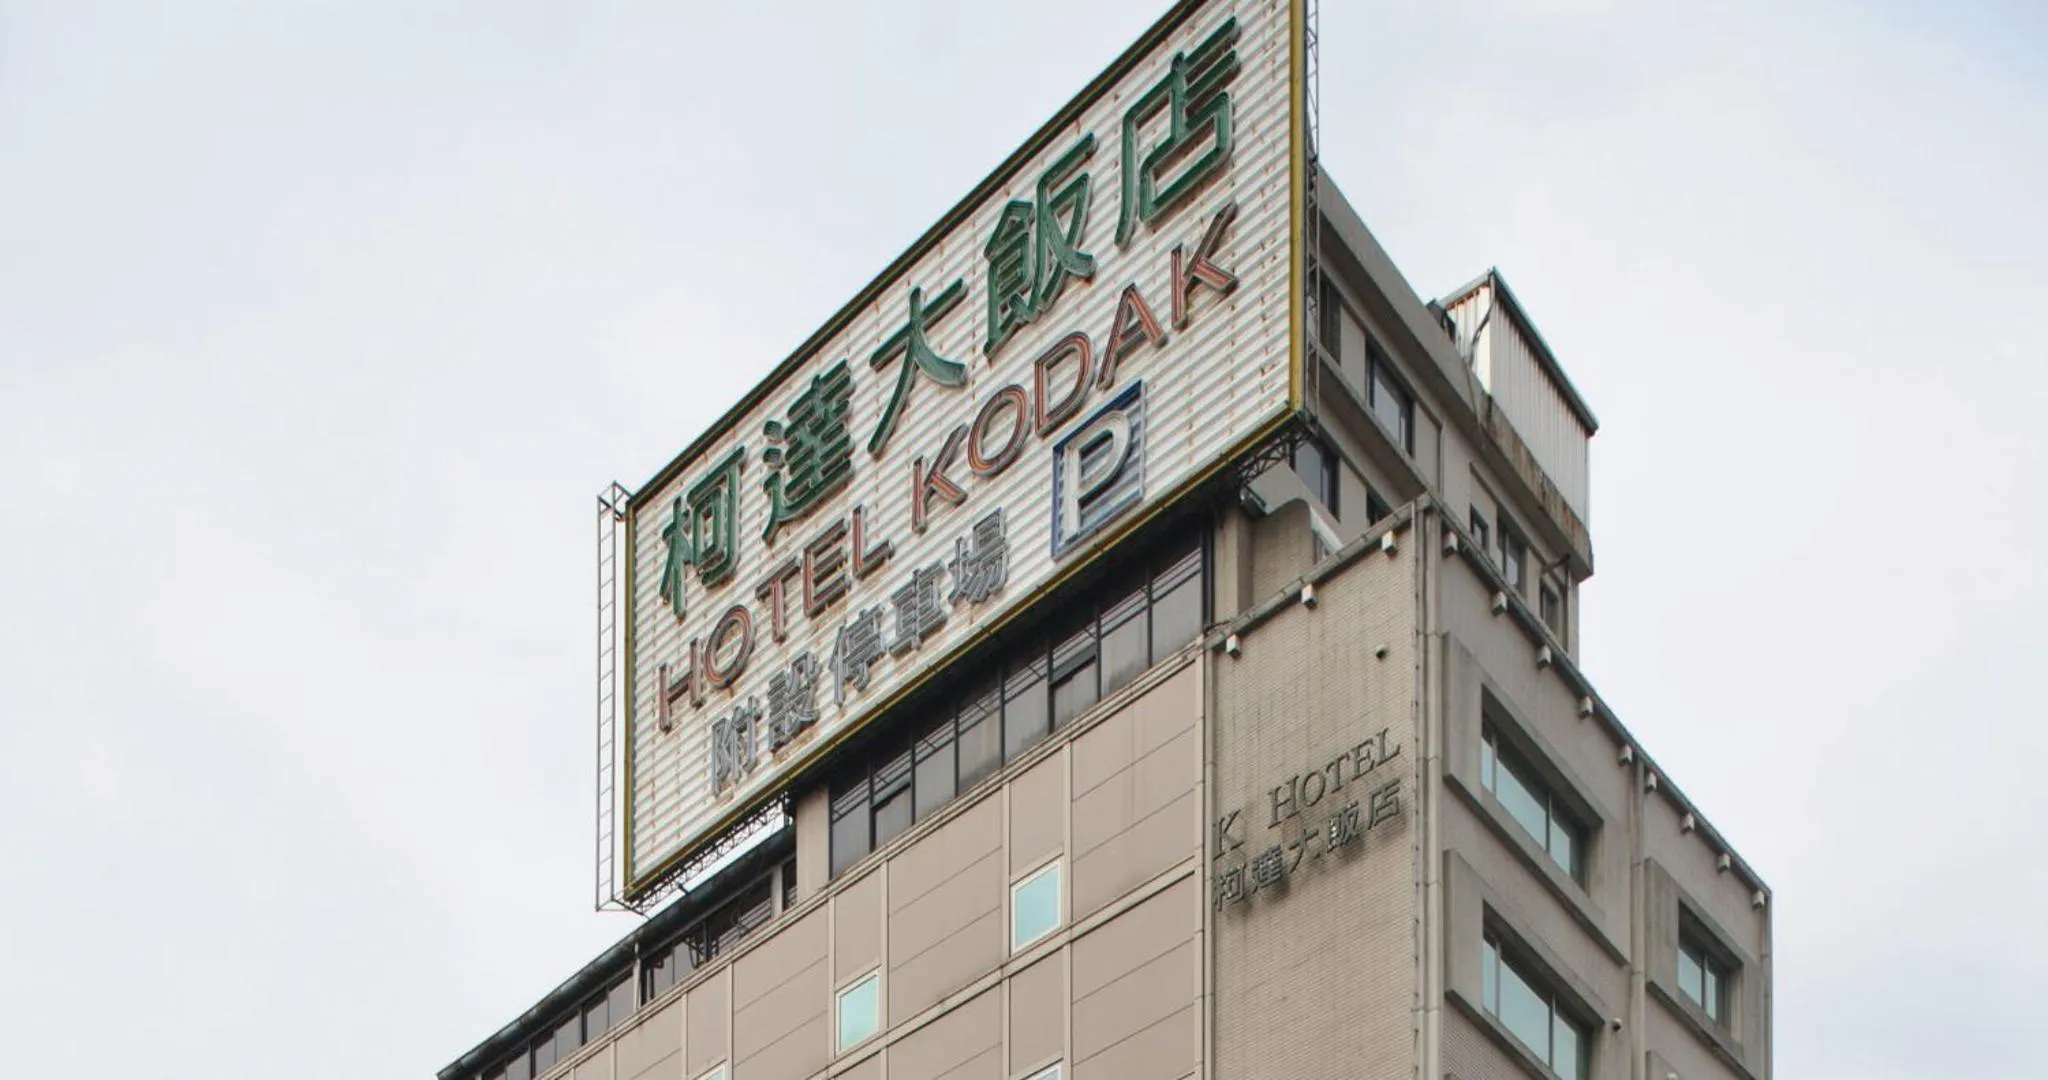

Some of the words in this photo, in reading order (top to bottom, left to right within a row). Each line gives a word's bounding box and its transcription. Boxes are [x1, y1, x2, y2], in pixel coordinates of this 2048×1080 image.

[660, 16, 1242, 622] 柯達大飯店
[657, 504, 896, 732] HOTEL
[911, 201, 1240, 533] KODAK
[1061, 409, 1132, 543] P
[711, 507, 1009, 797] 附設停車場
[1213, 808, 1244, 861] K
[1267, 727, 1401, 829] HOTEL
[1213, 777, 1401, 912] 柯達大飯店
